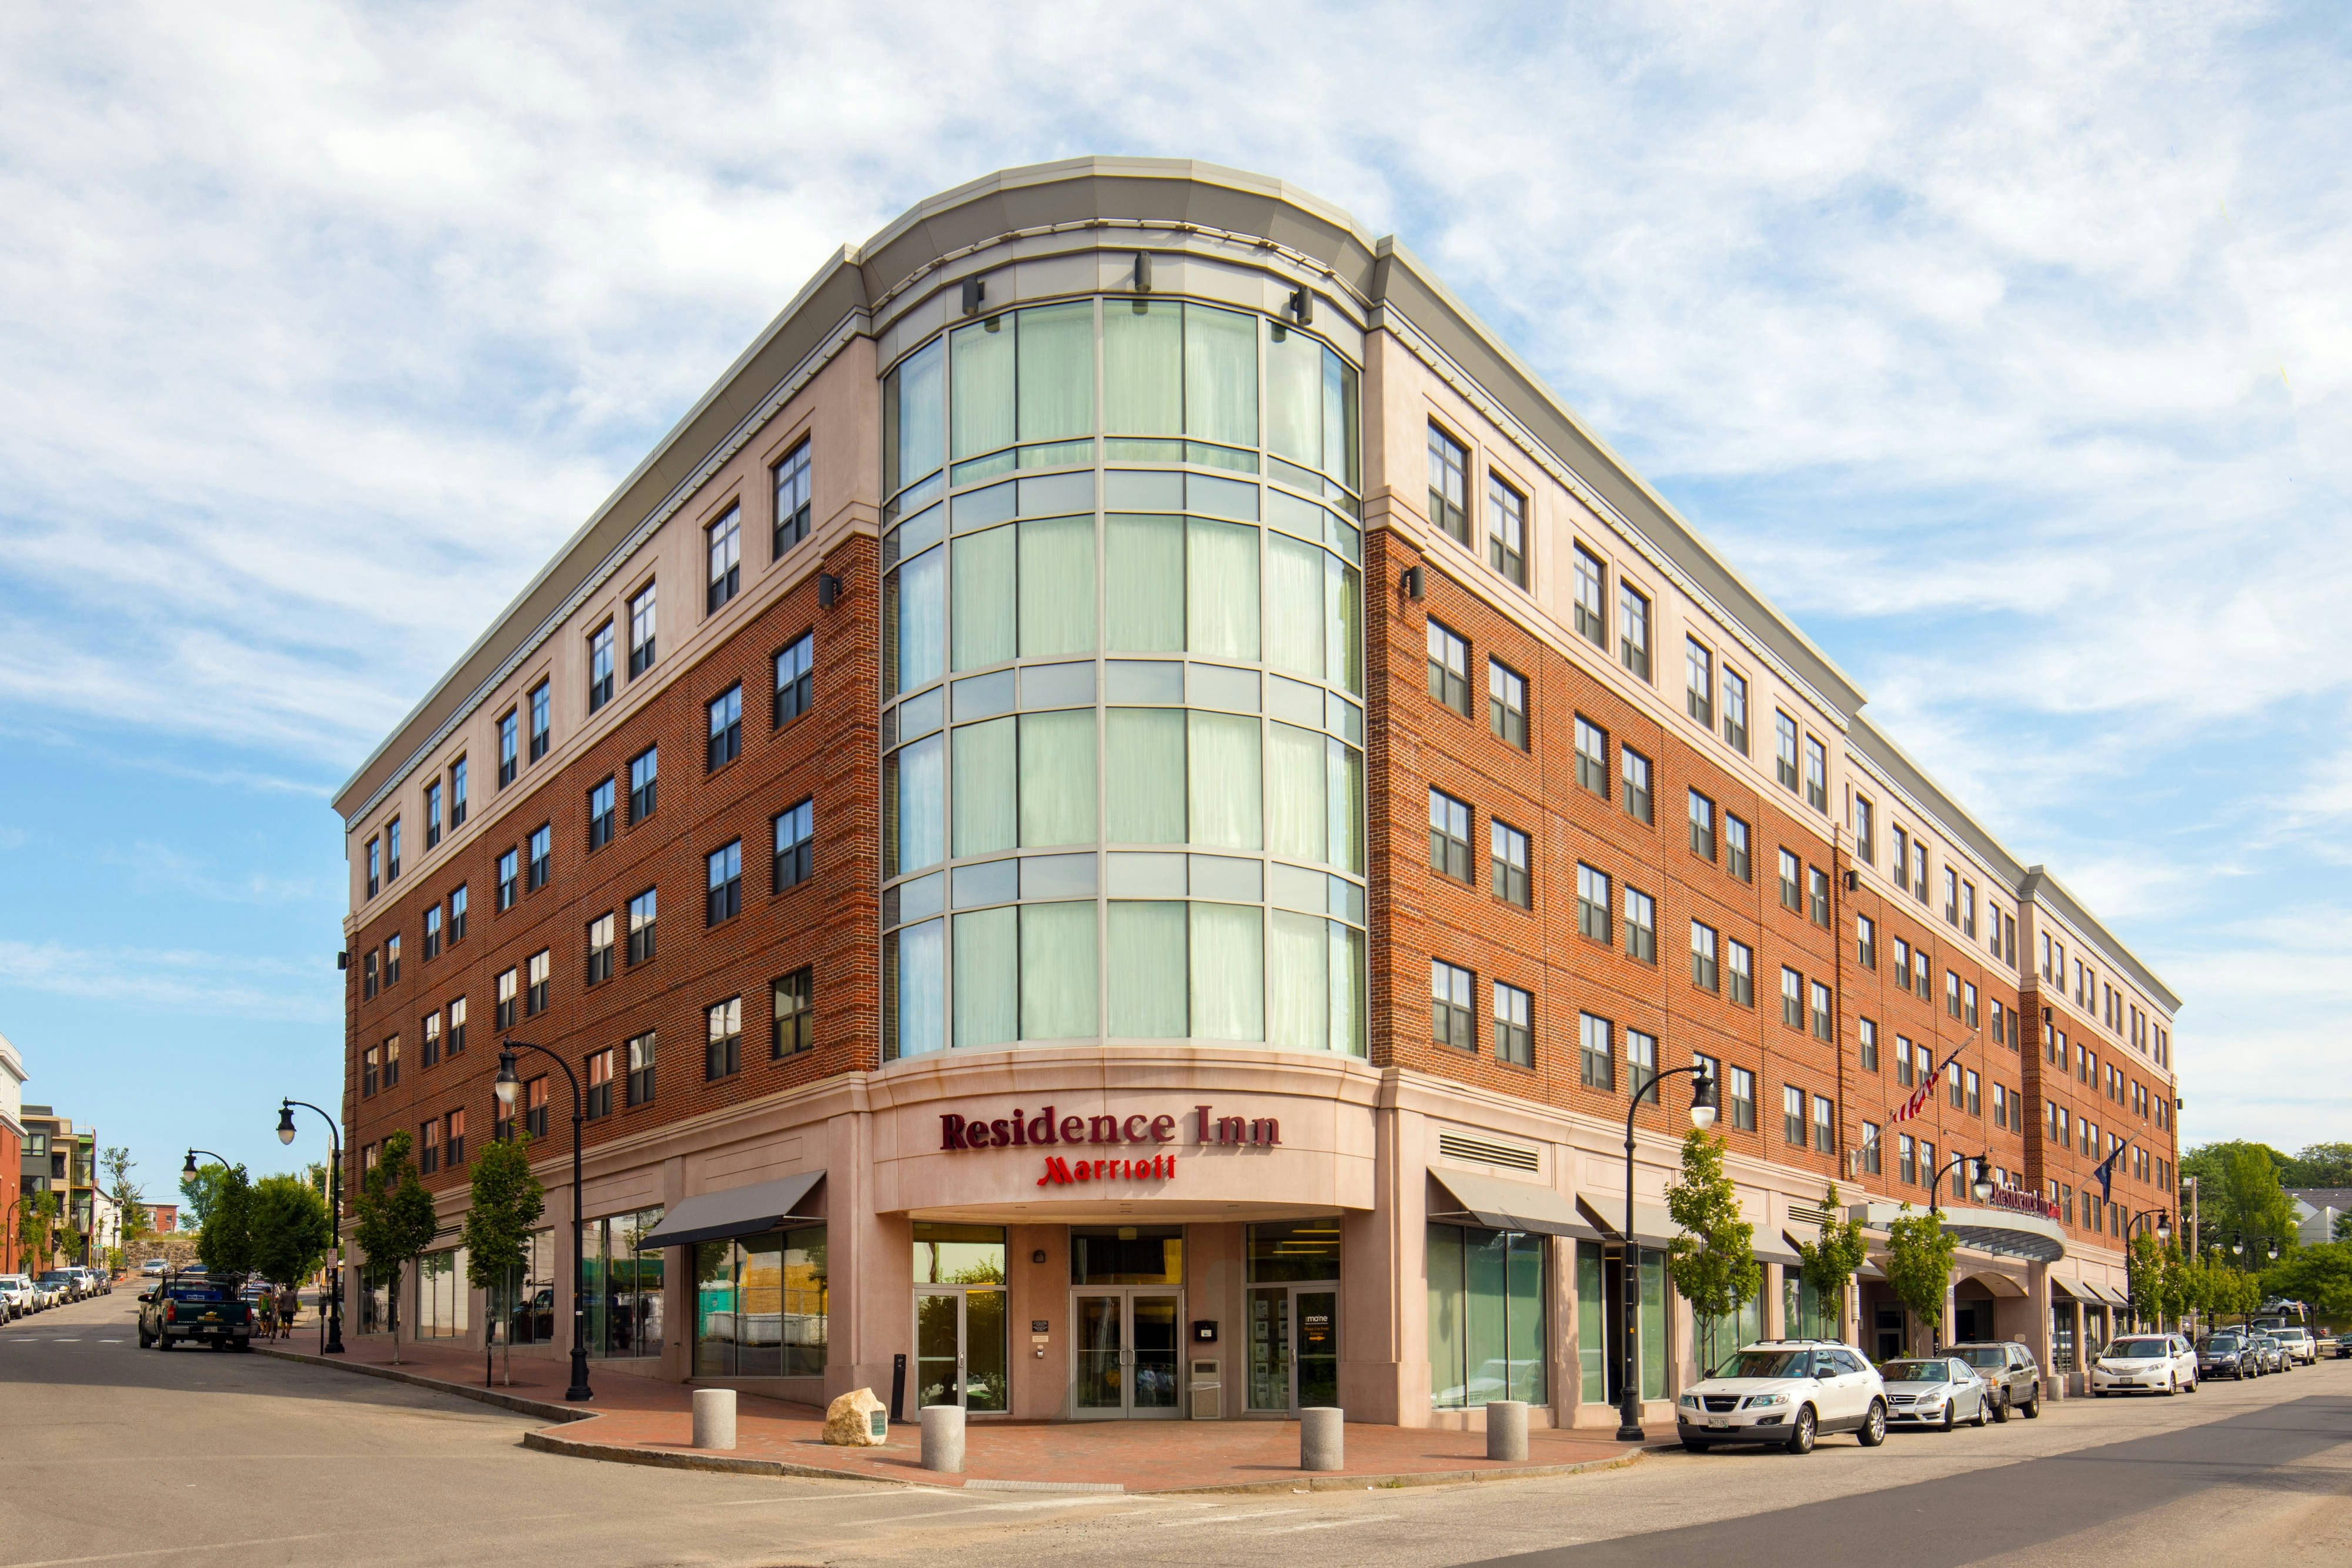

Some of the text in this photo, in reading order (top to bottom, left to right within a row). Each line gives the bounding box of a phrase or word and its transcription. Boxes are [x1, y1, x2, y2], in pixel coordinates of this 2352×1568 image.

[940, 1105, 1282, 1149] Residence Inn
[1037, 1154, 1176, 1186] Marriott
